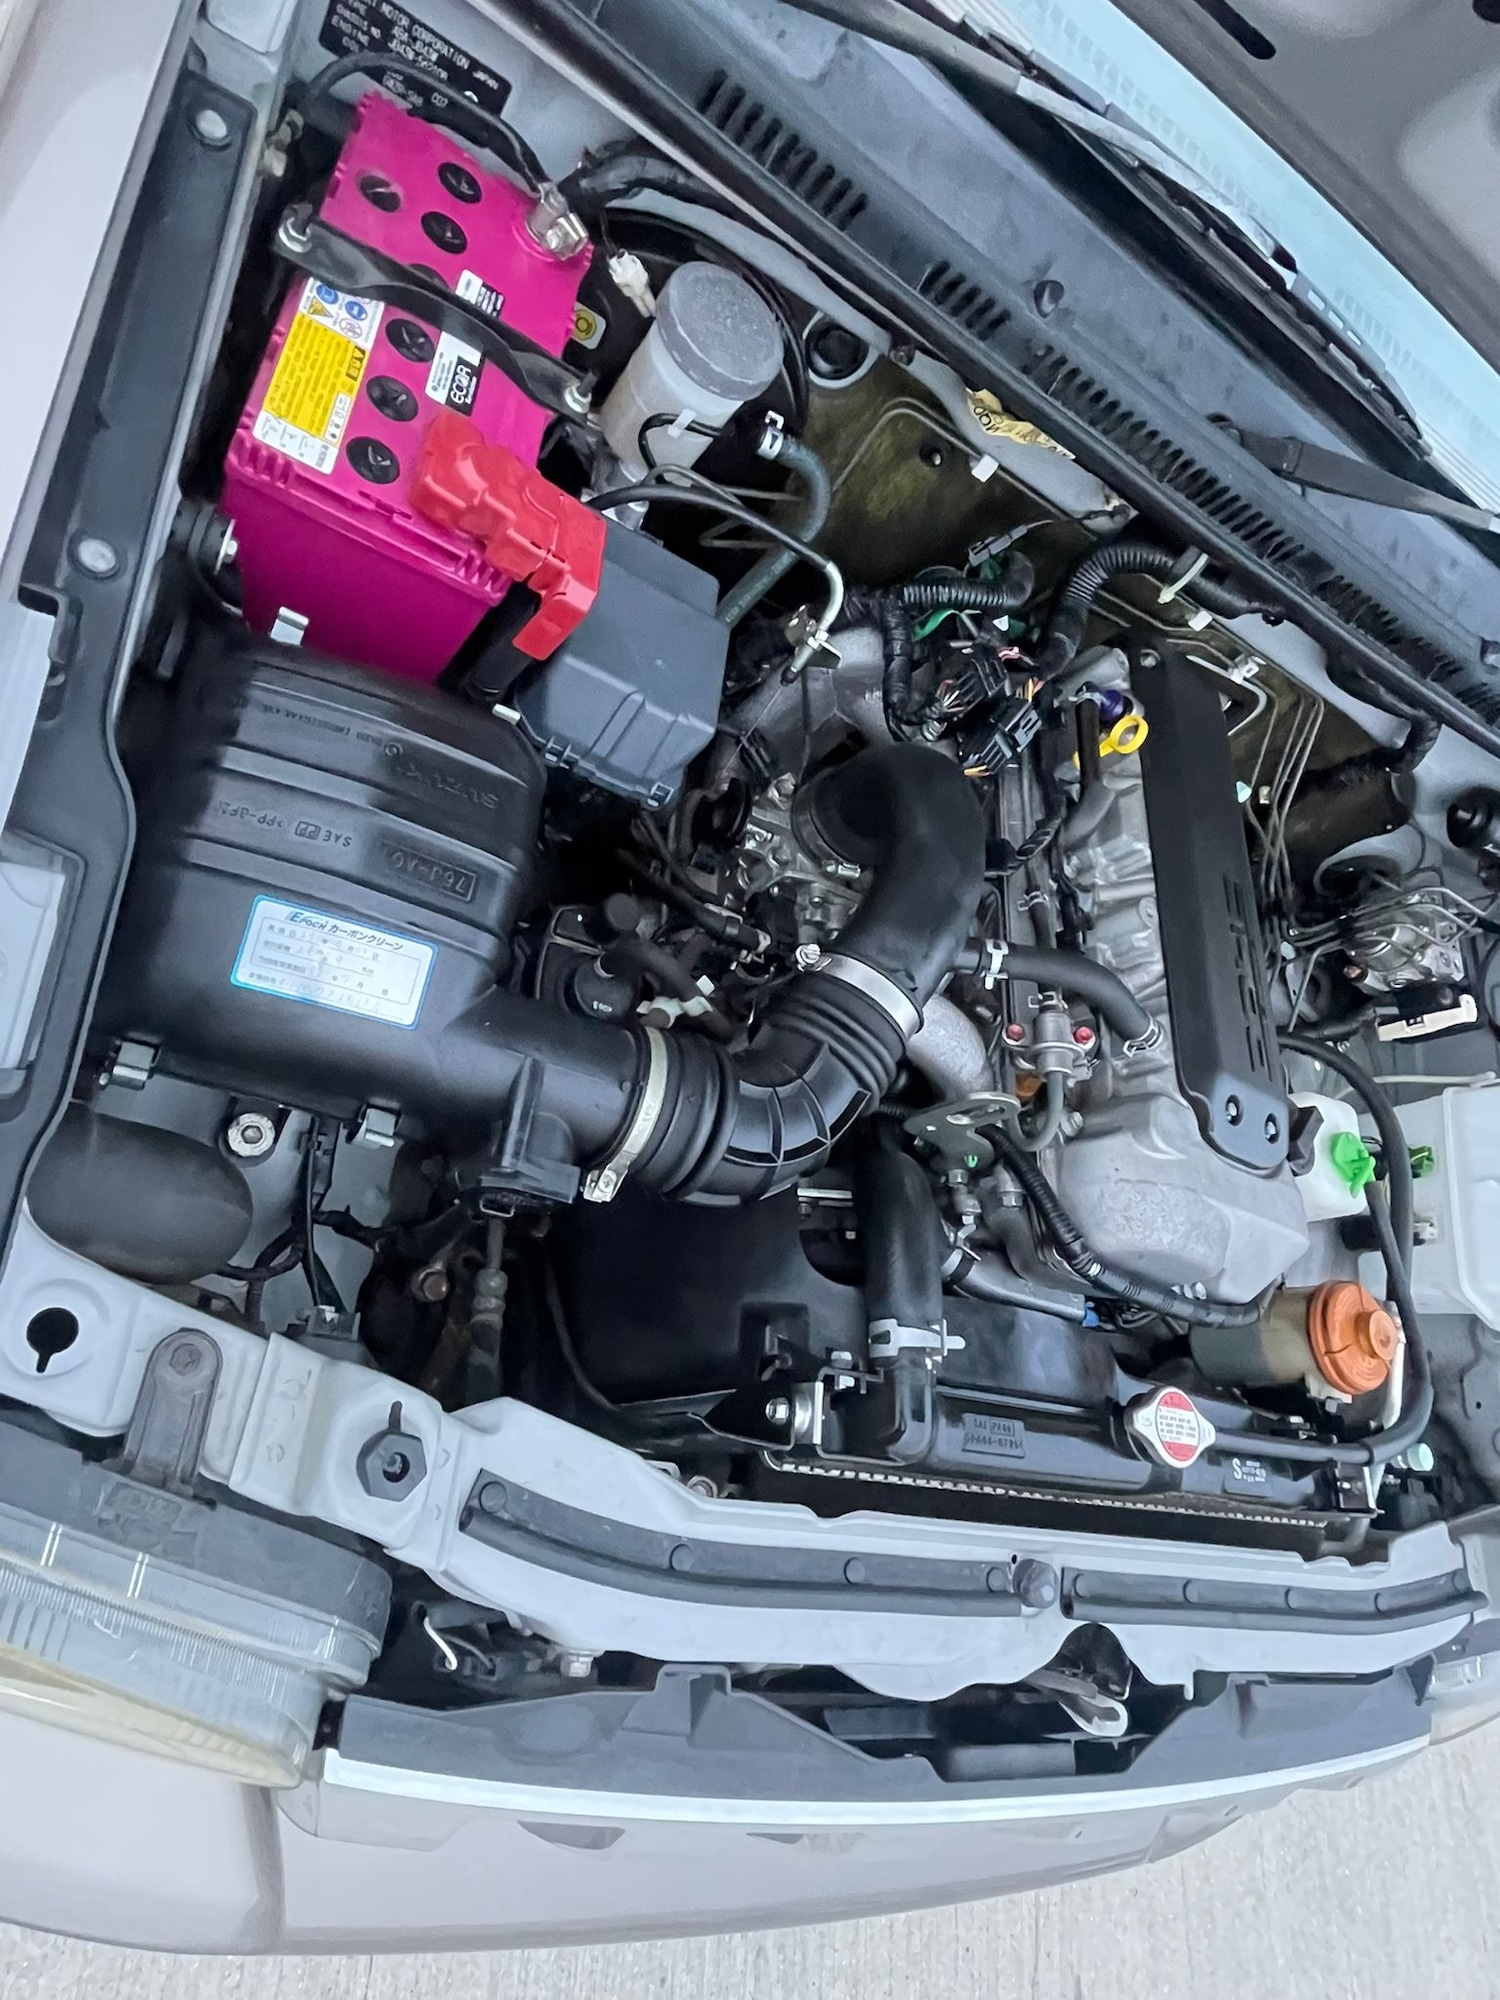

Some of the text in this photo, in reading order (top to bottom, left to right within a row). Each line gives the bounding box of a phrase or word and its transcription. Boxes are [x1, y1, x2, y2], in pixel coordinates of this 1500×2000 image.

[381, 2, 499, 91] MOTOR CORPORATION JAPAN
[322, 829, 353, 848] SAE
[328, 924, 404, 951] カーボンクリーン
